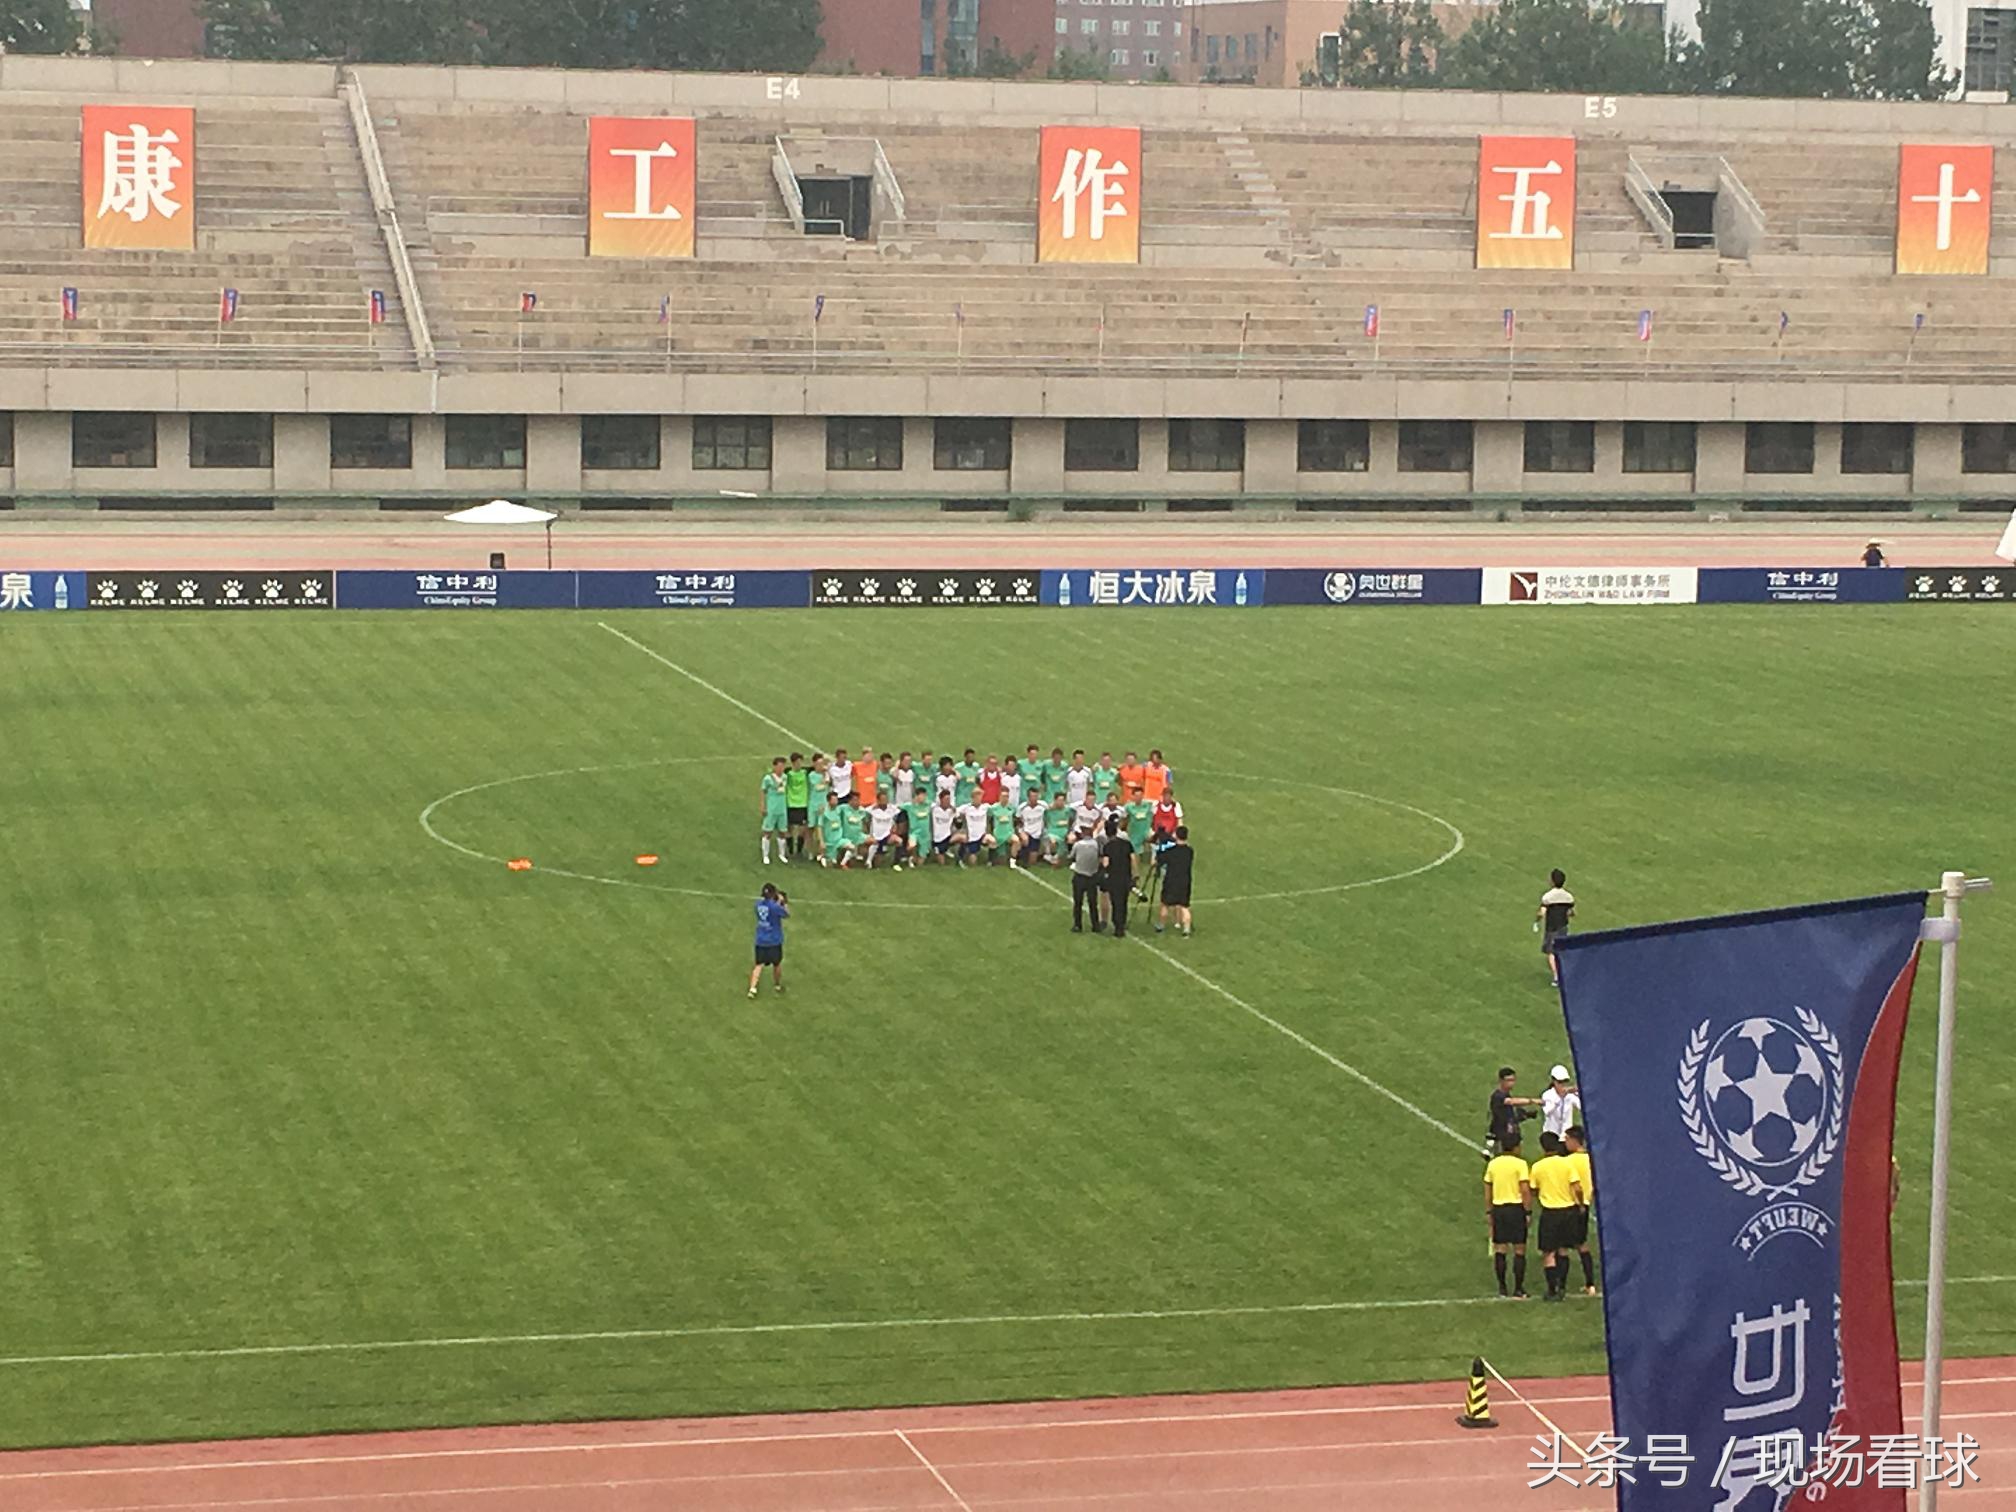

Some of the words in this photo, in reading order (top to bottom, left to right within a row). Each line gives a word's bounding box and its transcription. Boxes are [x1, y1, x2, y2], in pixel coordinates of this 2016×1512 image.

[766, 76, 801, 100] E4
[1584, 96, 1617, 118] E5
[97, 124, 183, 222] 康
[603, 141, 682, 221] 工
[1052, 147, 1130, 240] 作
[1488, 160, 1564, 240] 五
[1911, 163, 1982, 250] 十
[0, 573, 34, 609] 泉
[416, 574, 497, 590] 信中利
[656, 574, 735, 590] 信中利
[1089, 570, 1217, 605] 恒大冰泉
[1767, 571, 1838, 586] 信中利
